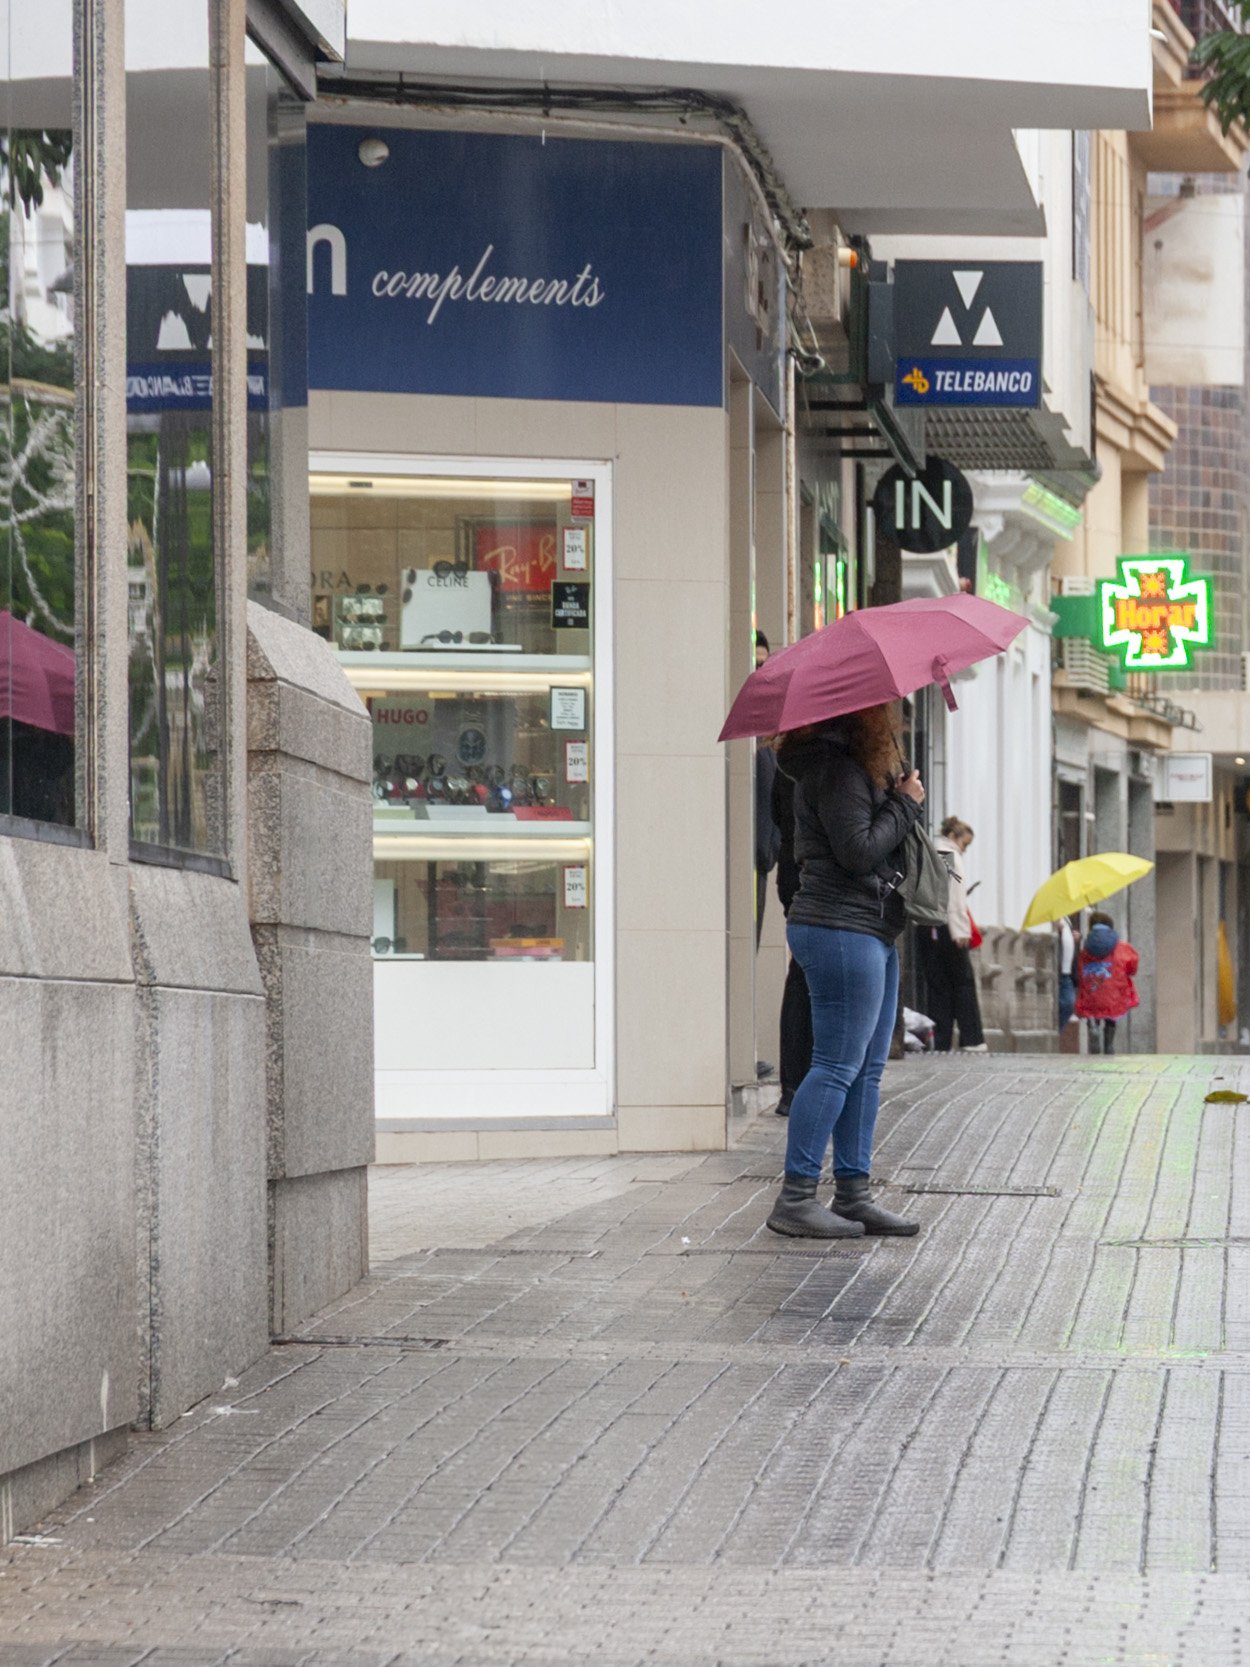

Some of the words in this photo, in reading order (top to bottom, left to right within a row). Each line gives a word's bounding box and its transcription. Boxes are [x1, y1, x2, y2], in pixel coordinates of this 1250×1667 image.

[372, 244, 605, 325] complements
[935, 371, 1032, 393] TELEBANCO
[896, 480, 952, 529] IN
[377, 709, 428, 724] HUGO
